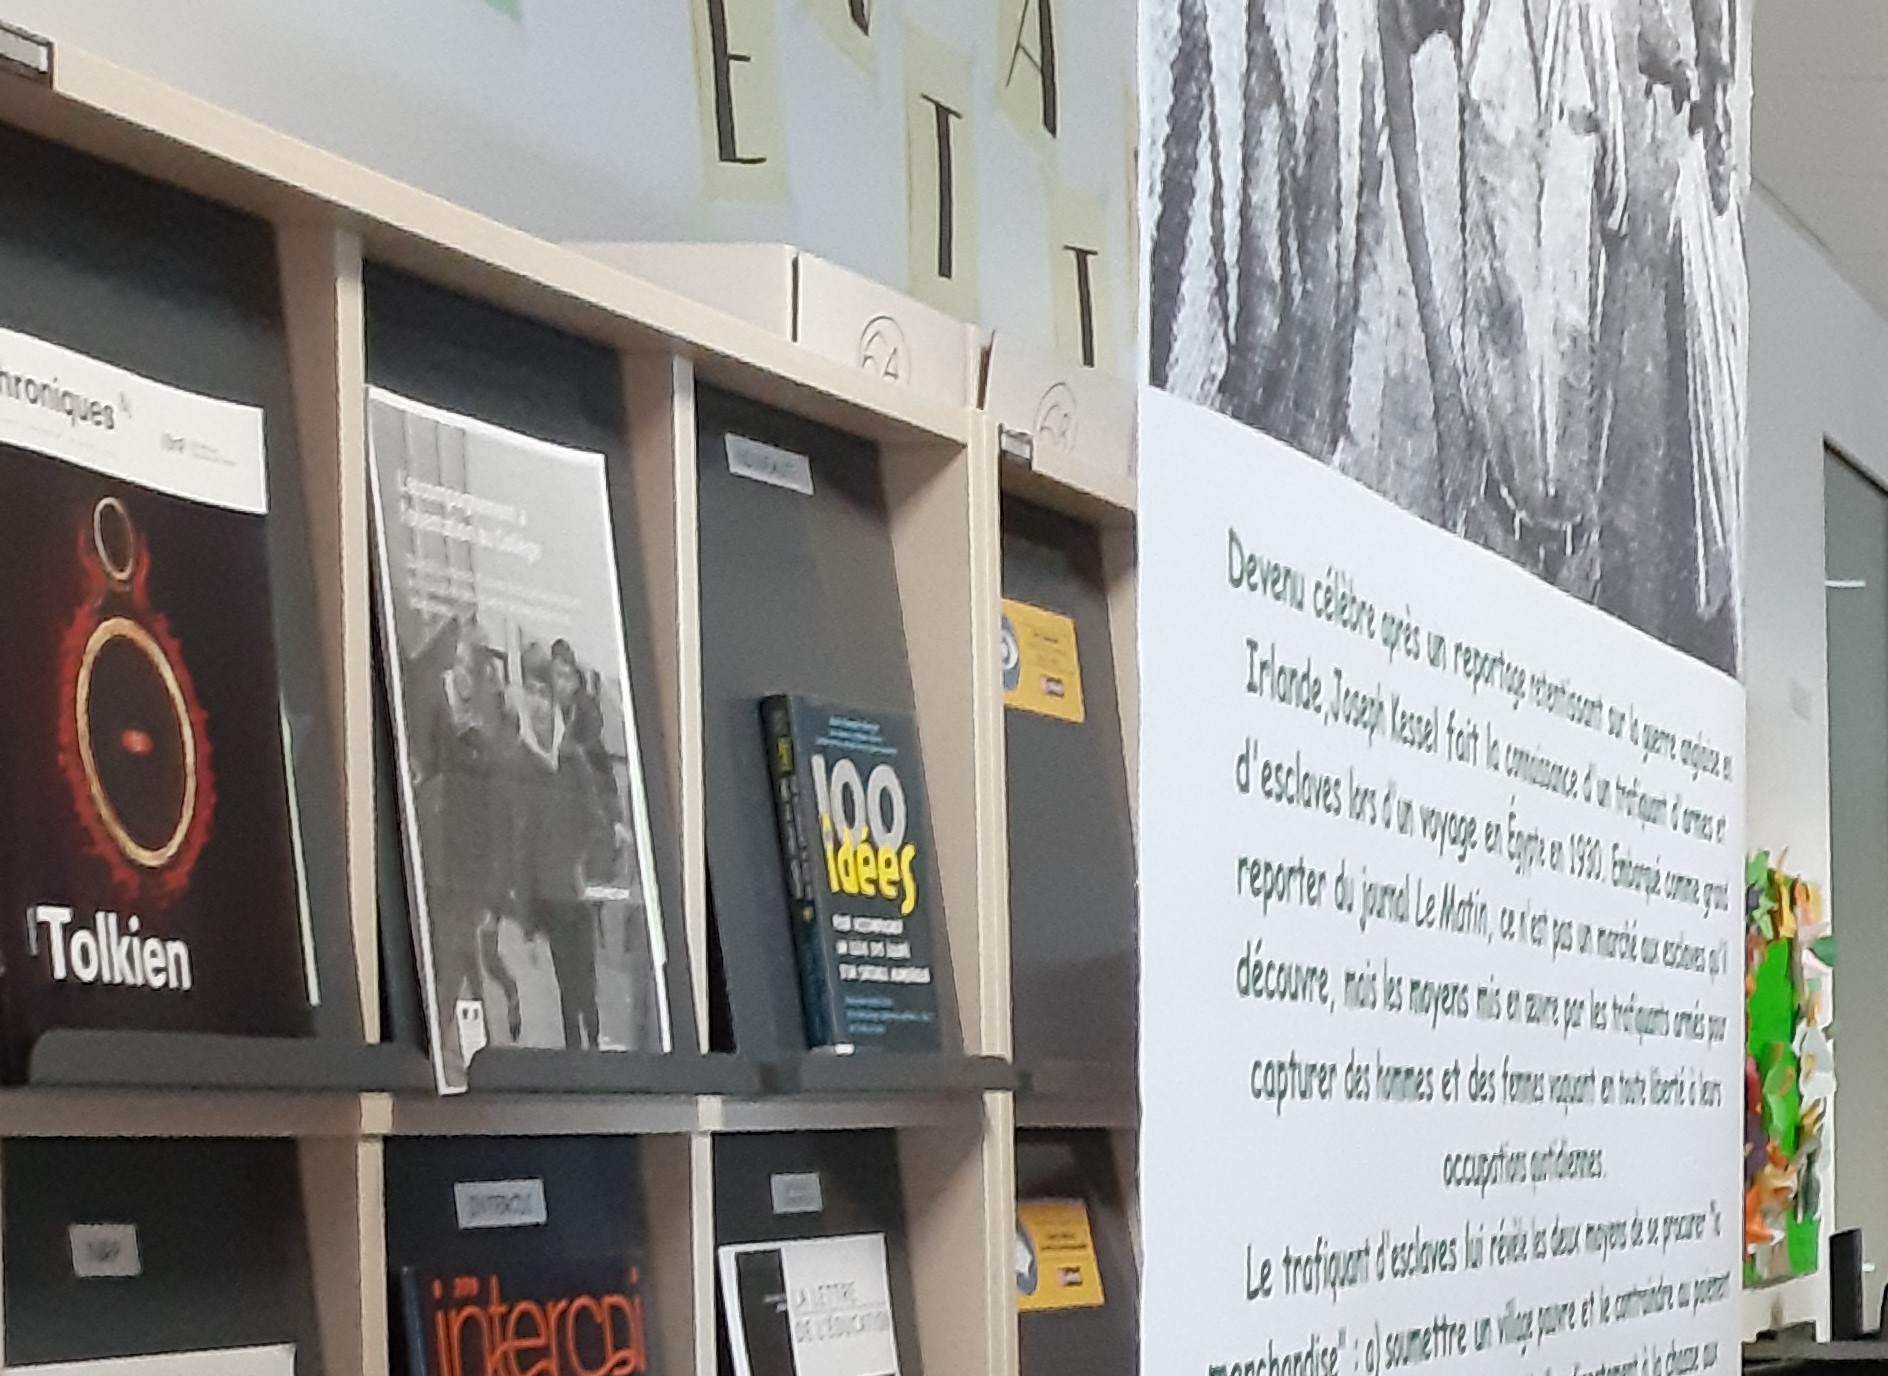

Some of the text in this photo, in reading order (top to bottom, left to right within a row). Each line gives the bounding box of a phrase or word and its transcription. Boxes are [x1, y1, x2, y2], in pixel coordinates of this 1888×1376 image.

[920, 93, 963, 280] T
[1063, 244, 1099, 368] T
[1228, 528, 1306, 613] Devenu
[1312, 566, 1377, 641] célèbre
[1381, 612, 1422, 666] après
[1390, 694, 1440, 755] Kessel
[1446, 709, 1481, 768] fait
[810, 753, 908, 852] 100
[1235, 737, 1343, 818] d'esclaves
[820, 811, 918, 917] idées
[1237, 856, 1328, 915] reporter
[1415, 878, 1436, 930] Le
[36, 904, 192, 992] Tolkien
[1236, 939, 1336, 1015] découvre,
[1408, 979, 1470, 1031] moyens
[1250, 1050, 1339, 1116] capturer
[1344, 1048, 1372, 1103] des
[1441, 1059, 1462, 1104] et
[1467, 1054, 1497, 1105] des
[1246, 1244, 1274, 1303] Le
[1281, 1236, 1372, 1306] trafiquant
[1375, 1225, 1459, 1283] d'esclaves
